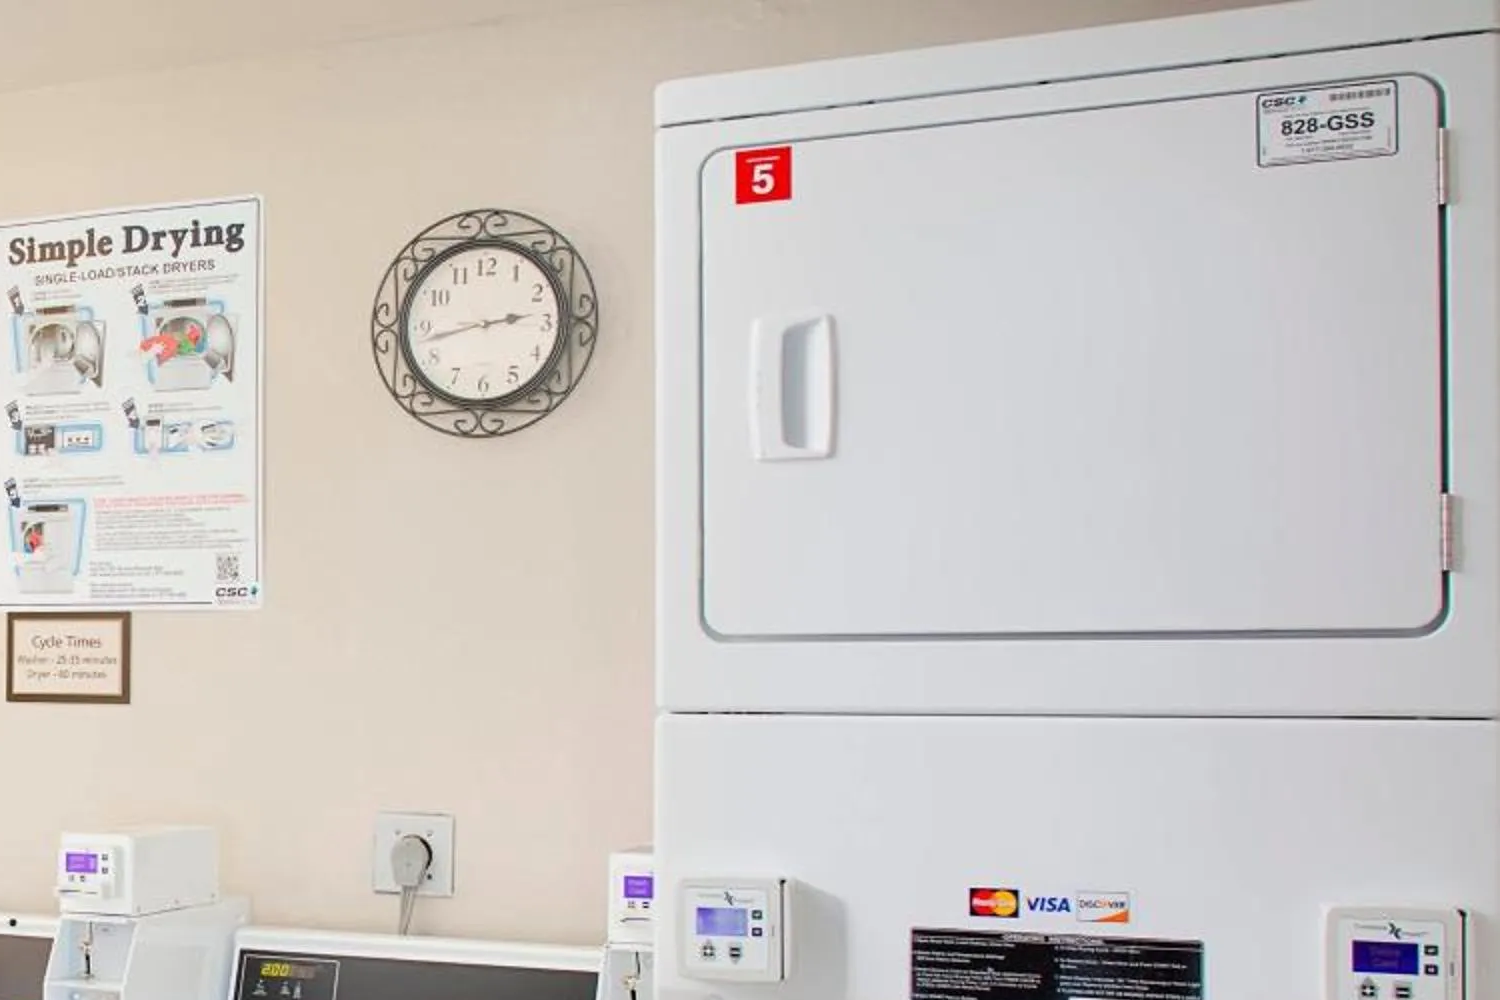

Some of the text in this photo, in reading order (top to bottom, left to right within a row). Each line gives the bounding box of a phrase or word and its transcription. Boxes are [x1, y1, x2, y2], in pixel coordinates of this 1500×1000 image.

[1261, 95, 1296, 109] CSC
[1281, 111, 1376, 137] 828-GSS
[751, 163, 775, 195] 5
[8, 219, 246, 268] Simple Drying
[162, 259, 216, 274] DRYERS
[476, 257, 498, 277] 12
[512, 264, 520, 282] 1
[452, 267, 468, 285] 11
[431, 289, 451, 307] 10
[531, 283, 544, 303] 2
[419, 320, 432, 334] 9
[540, 313, 552, 333] 3
[530, 344, 541, 362] 4
[451, 367, 461, 385] 7
[477, 374, 490, 394] 6
[506, 365, 520, 385] 5
[215, 587, 249, 597] CSC
[30, 635, 103, 651] Cycle Times
[1026, 897, 1072, 913] VISA
